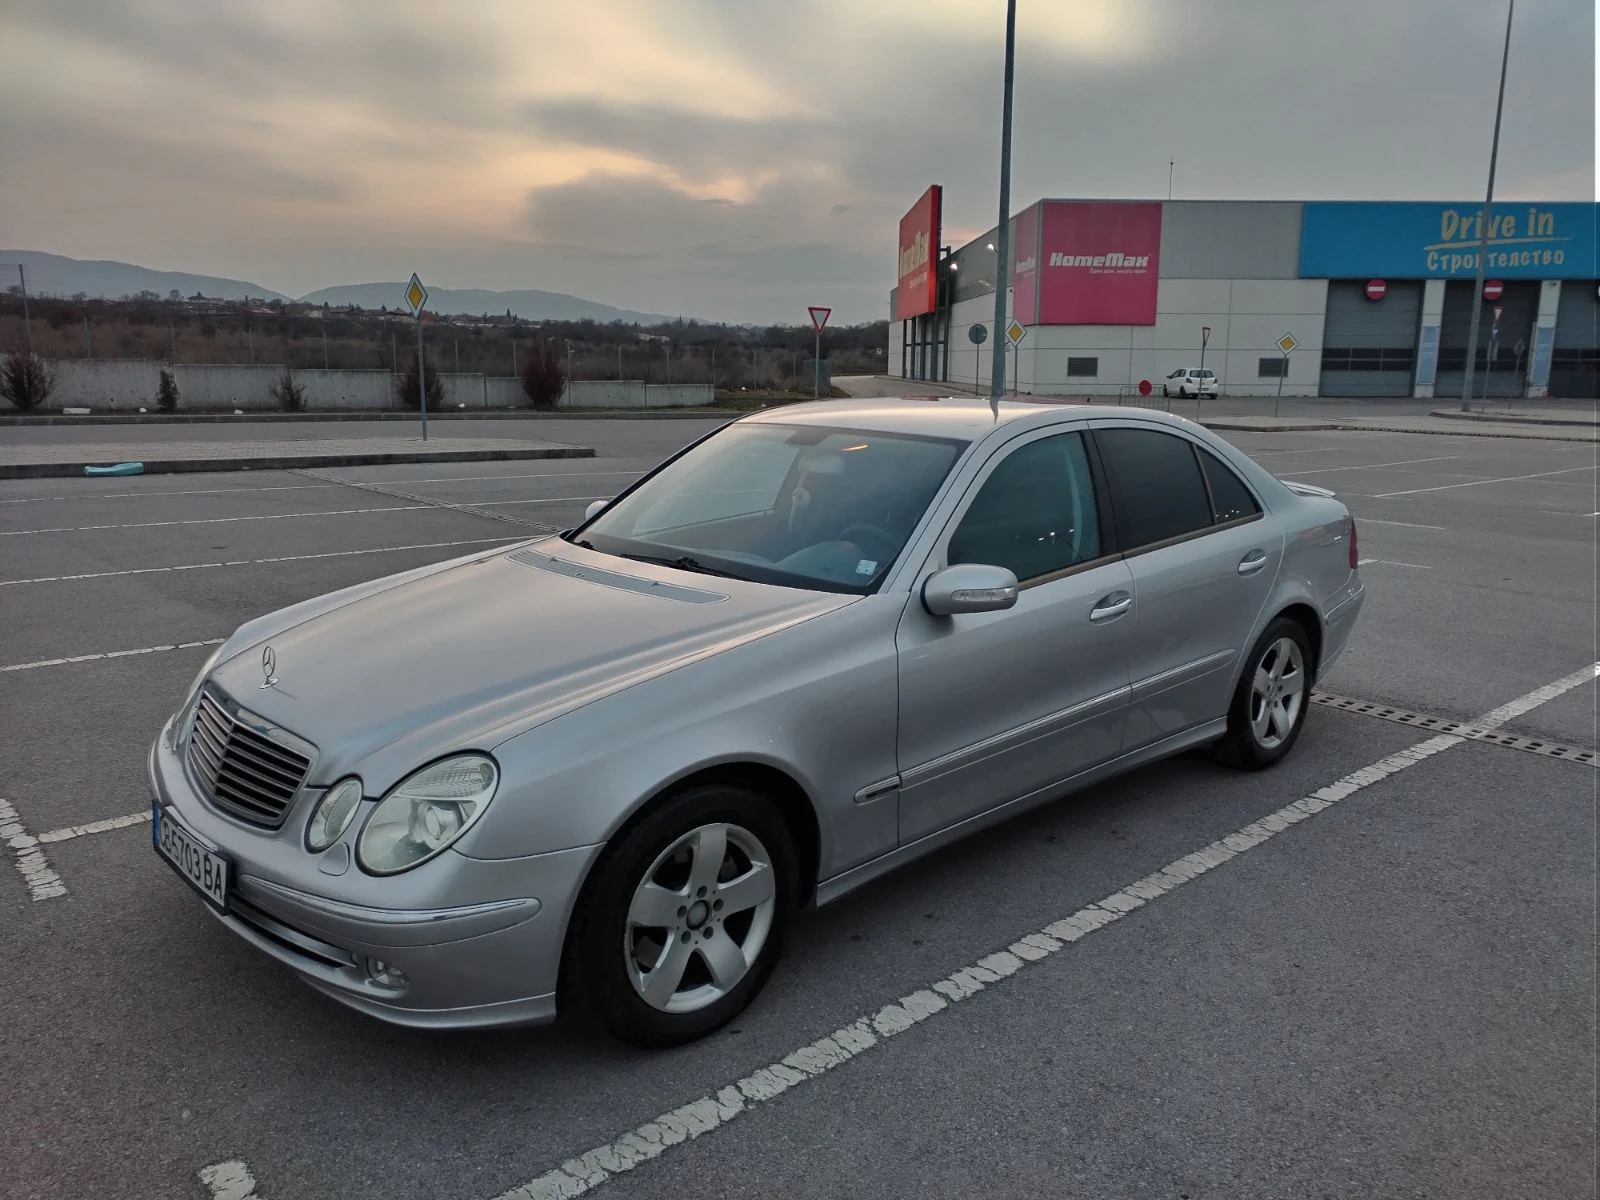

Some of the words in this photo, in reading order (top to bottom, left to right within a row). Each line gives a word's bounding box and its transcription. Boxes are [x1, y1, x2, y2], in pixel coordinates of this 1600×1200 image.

[1441, 209, 1516, 241] Drive
[1528, 207, 1554, 236] in
[1049, 252, 1149, 267] HomeMax
